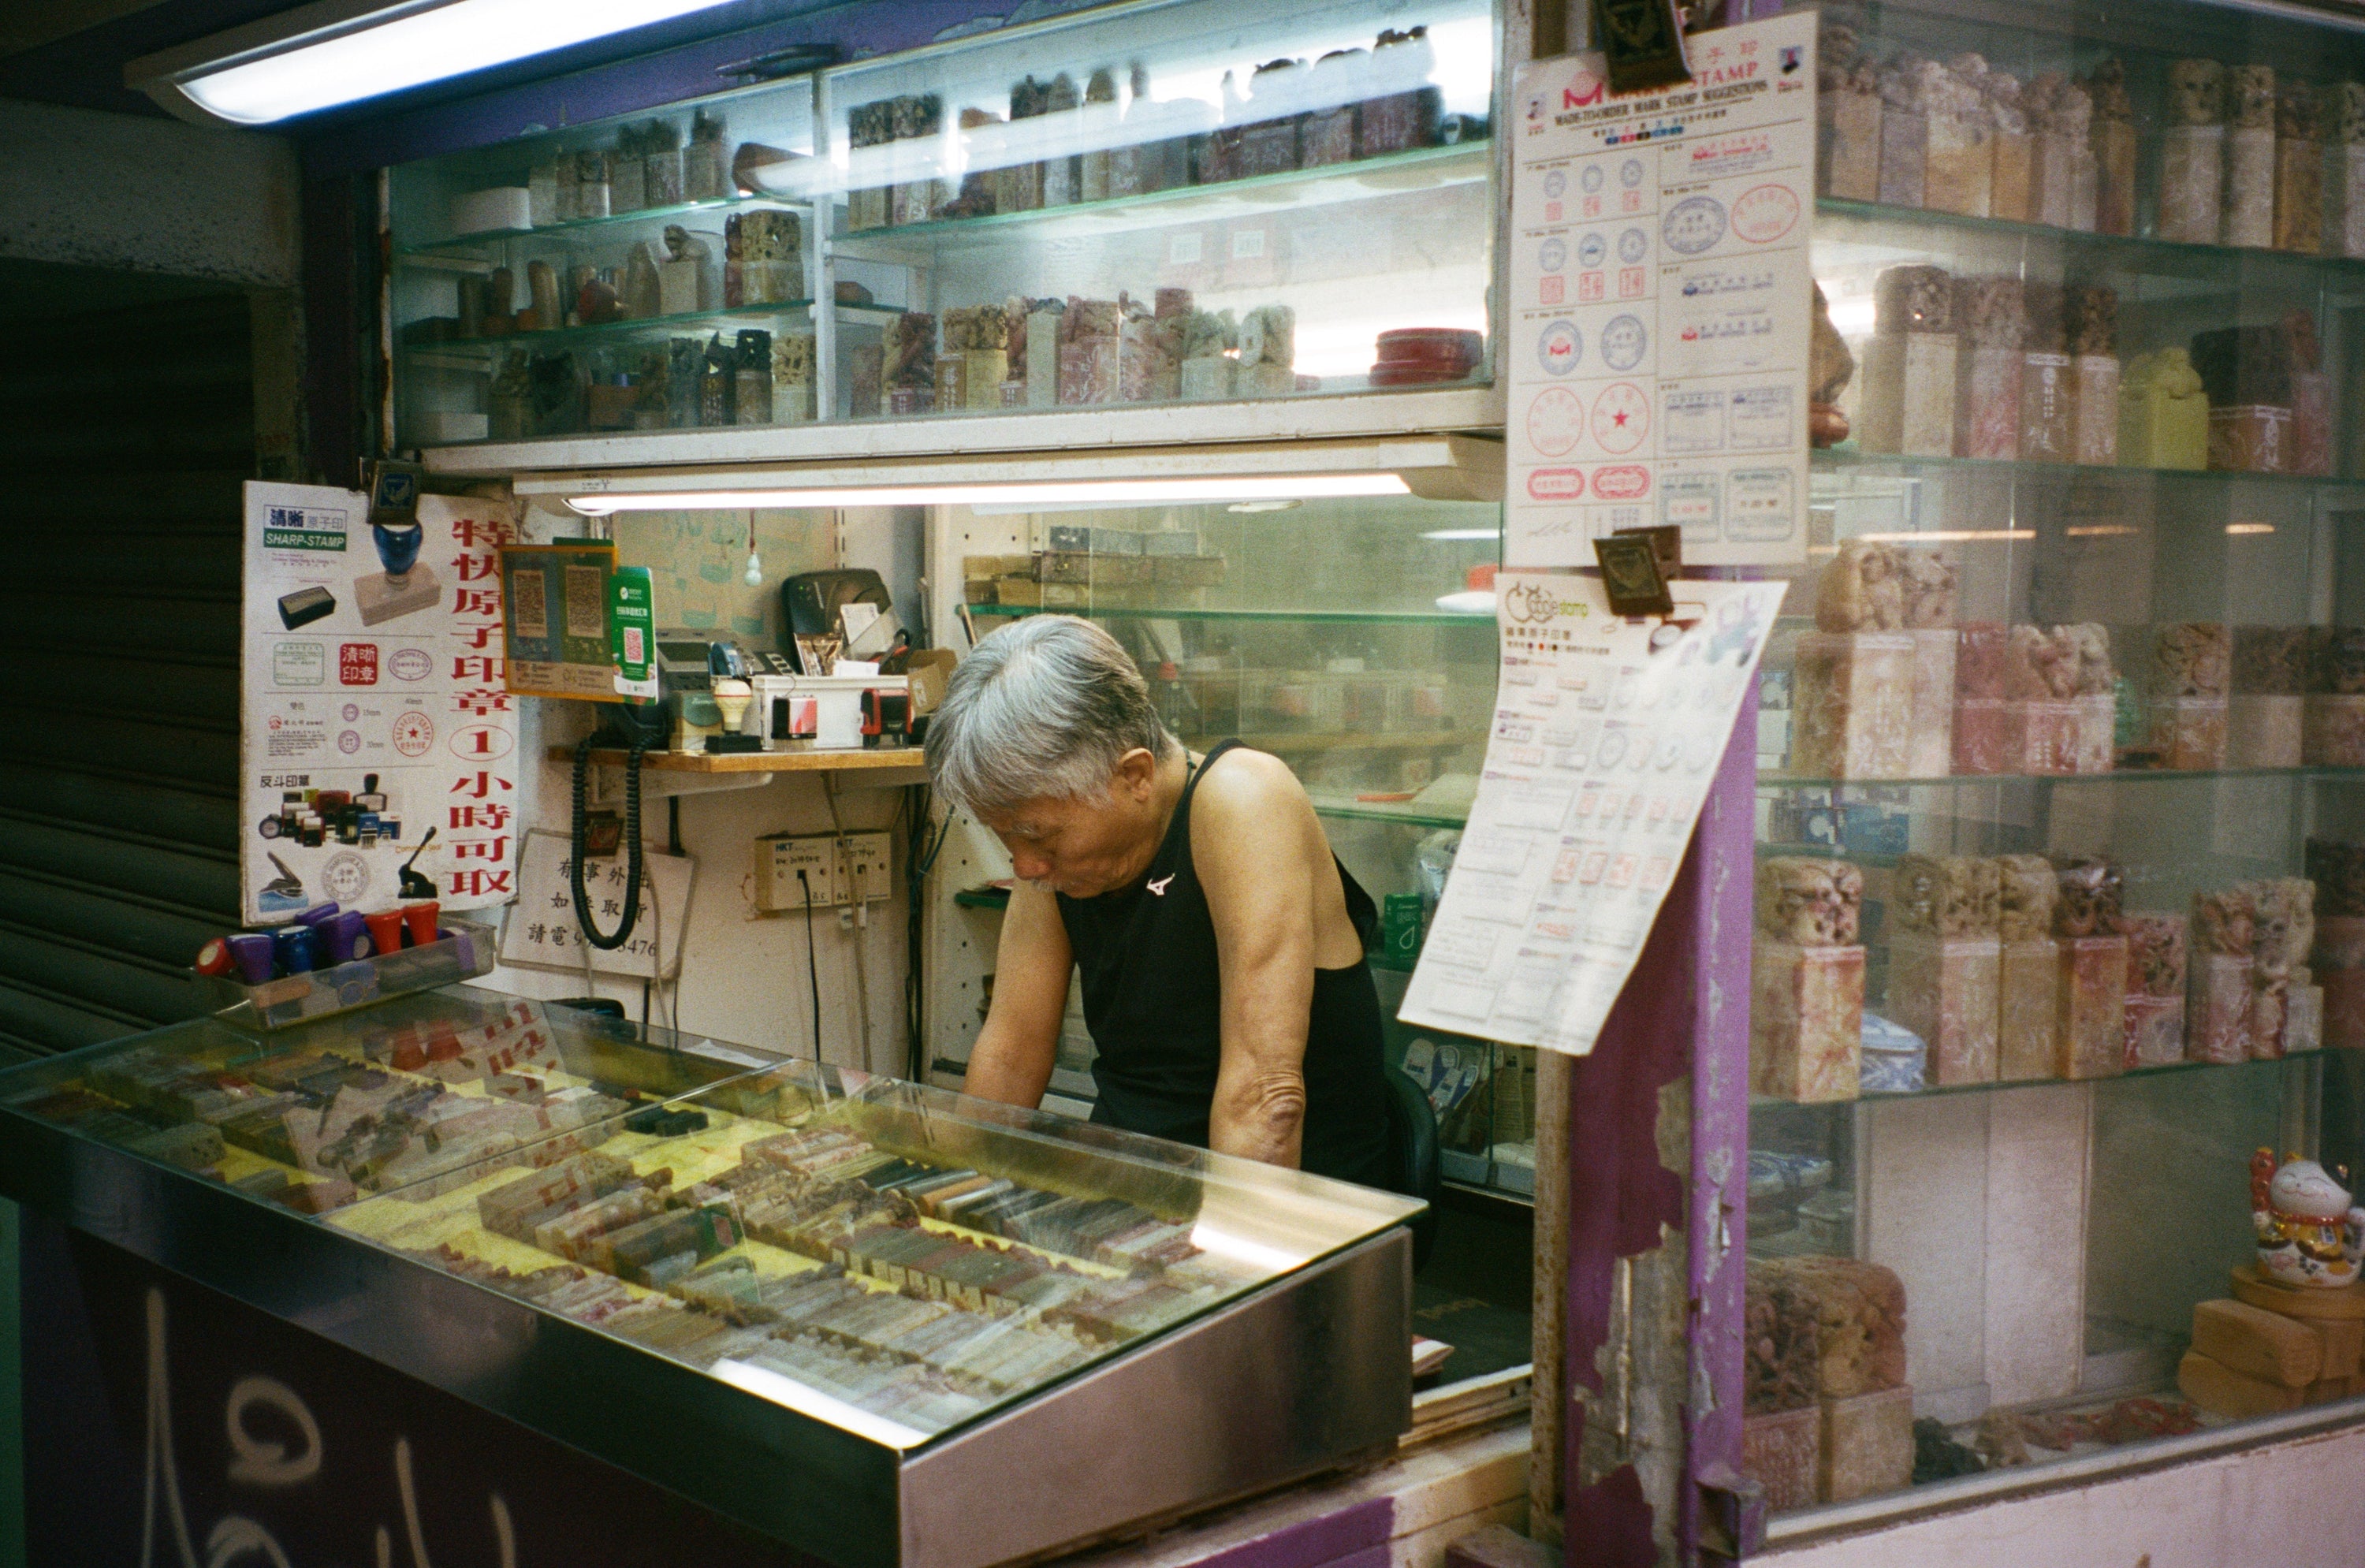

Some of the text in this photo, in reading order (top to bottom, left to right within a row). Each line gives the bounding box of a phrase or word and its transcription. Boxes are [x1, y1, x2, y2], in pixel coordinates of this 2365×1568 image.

[270, 508, 304, 528] 清晰
[266, 533, 345, 548] SHARP-STAMP
[342, 646, 376, 663] 清晰
[342, 665, 374, 682] 印章
